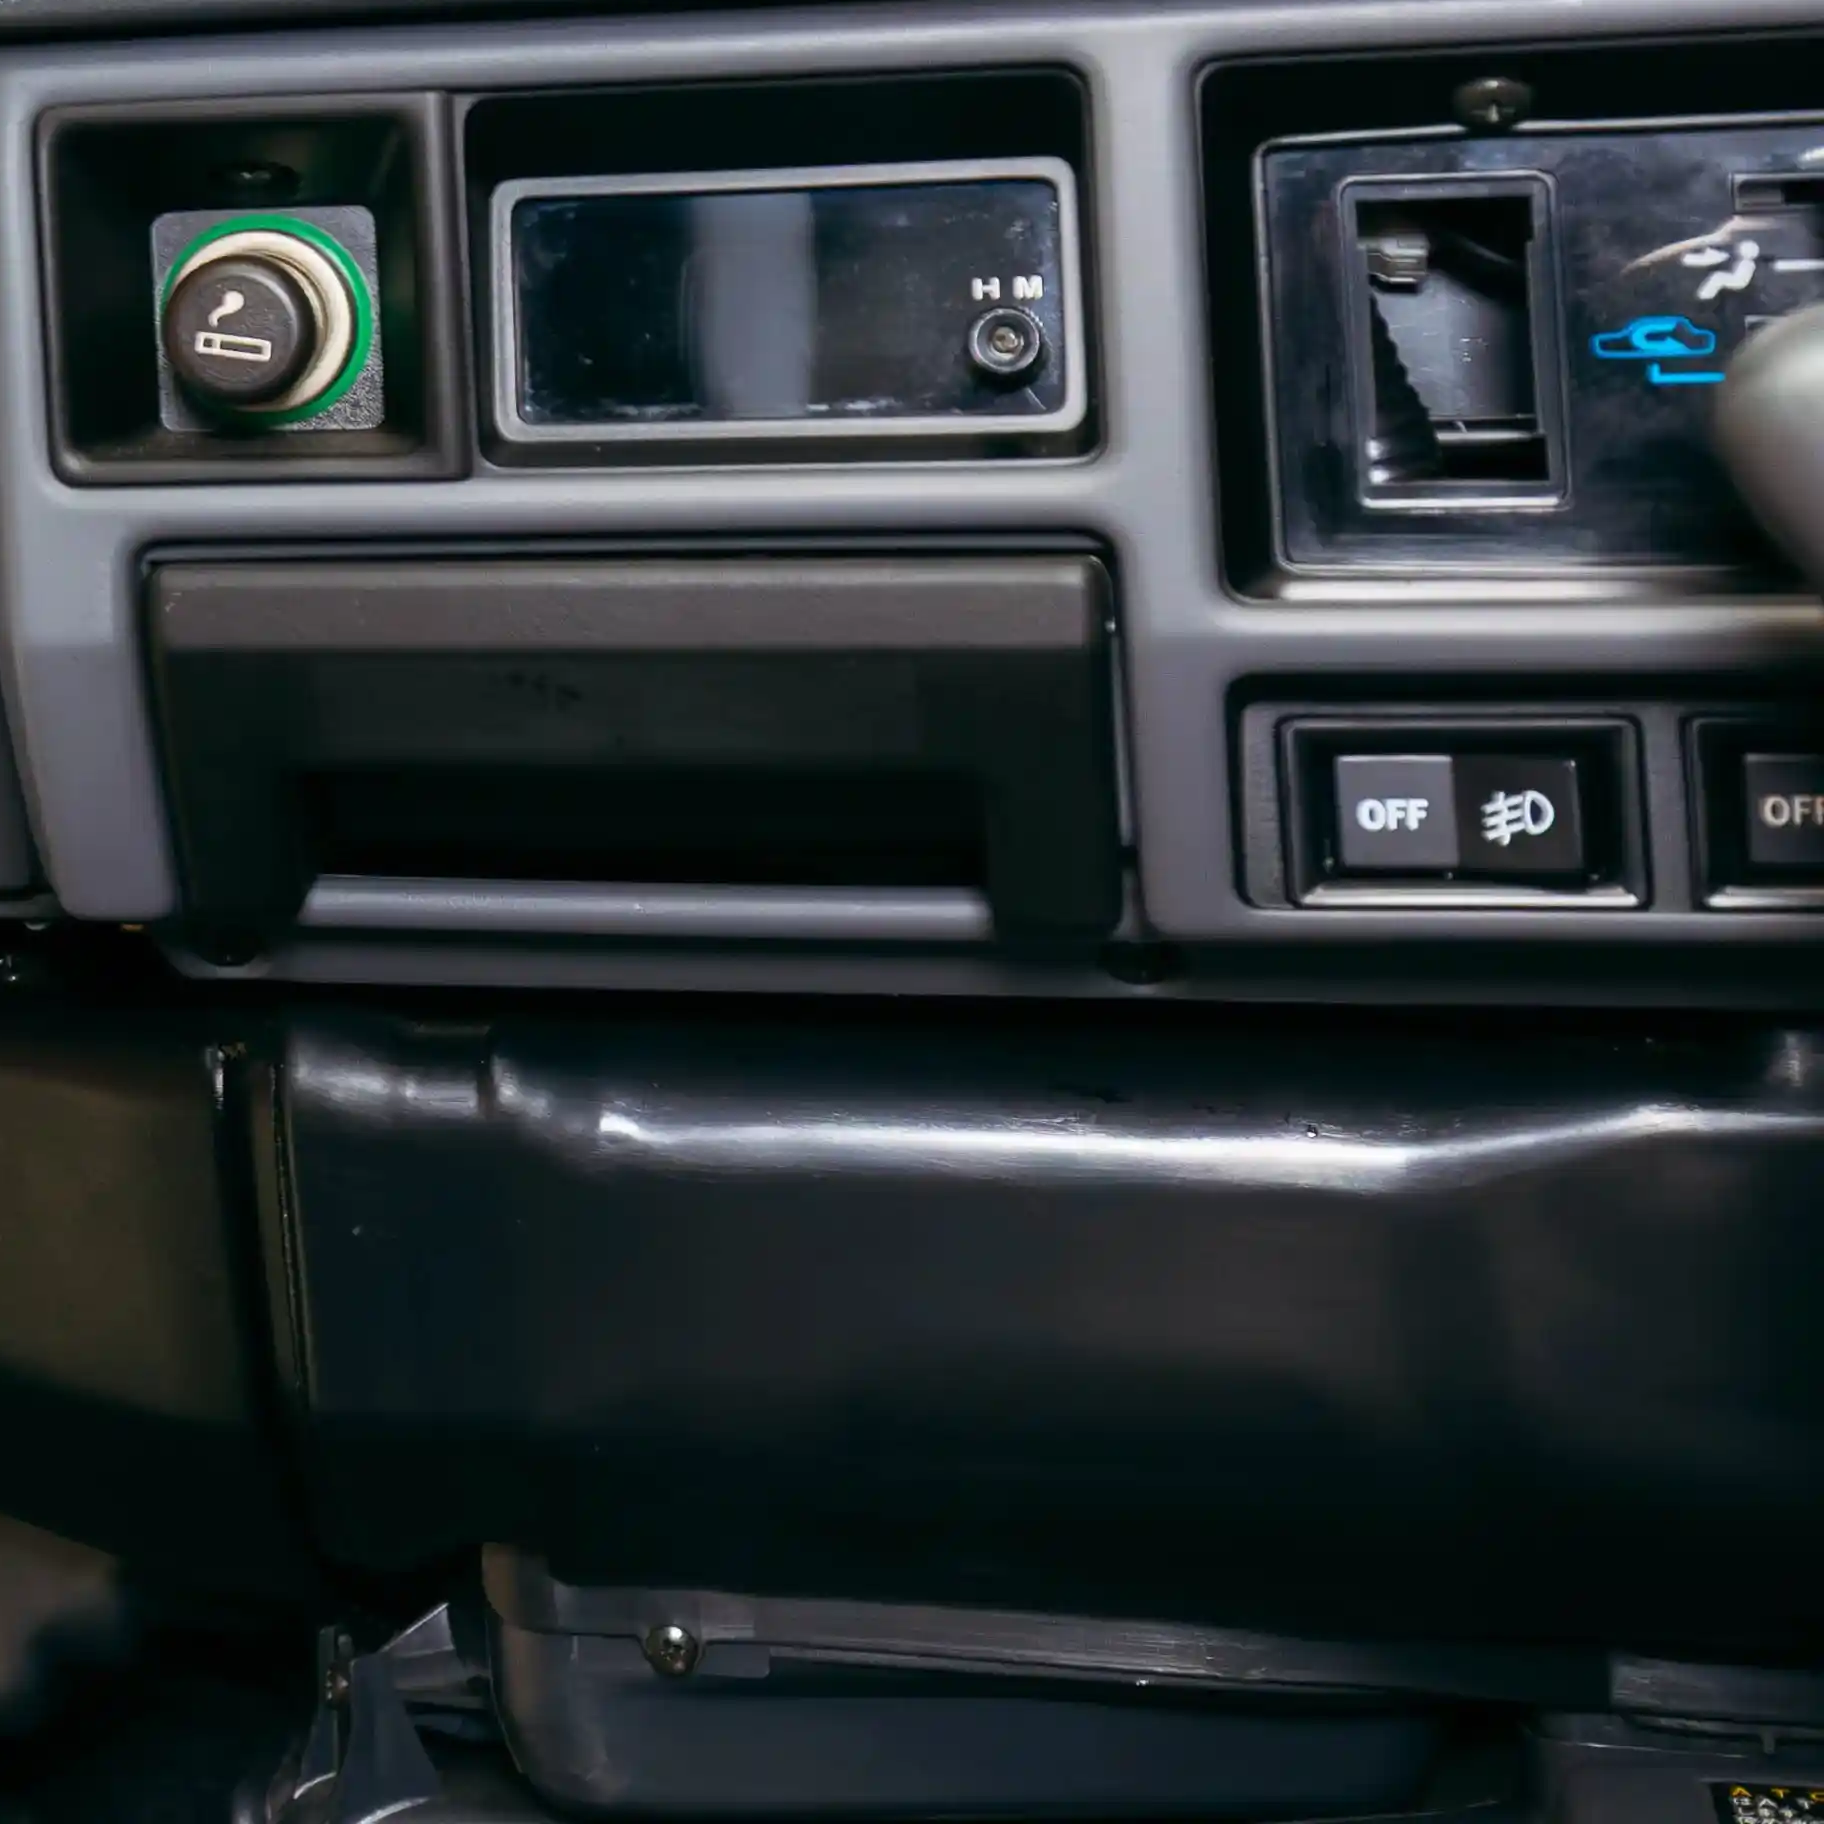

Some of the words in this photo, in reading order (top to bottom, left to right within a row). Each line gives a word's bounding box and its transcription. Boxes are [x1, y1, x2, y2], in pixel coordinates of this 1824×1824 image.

[971, 276, 1001, 300] H
[1012, 275, 1044, 299] M
[1356, 798, 1429, 832] OFF
